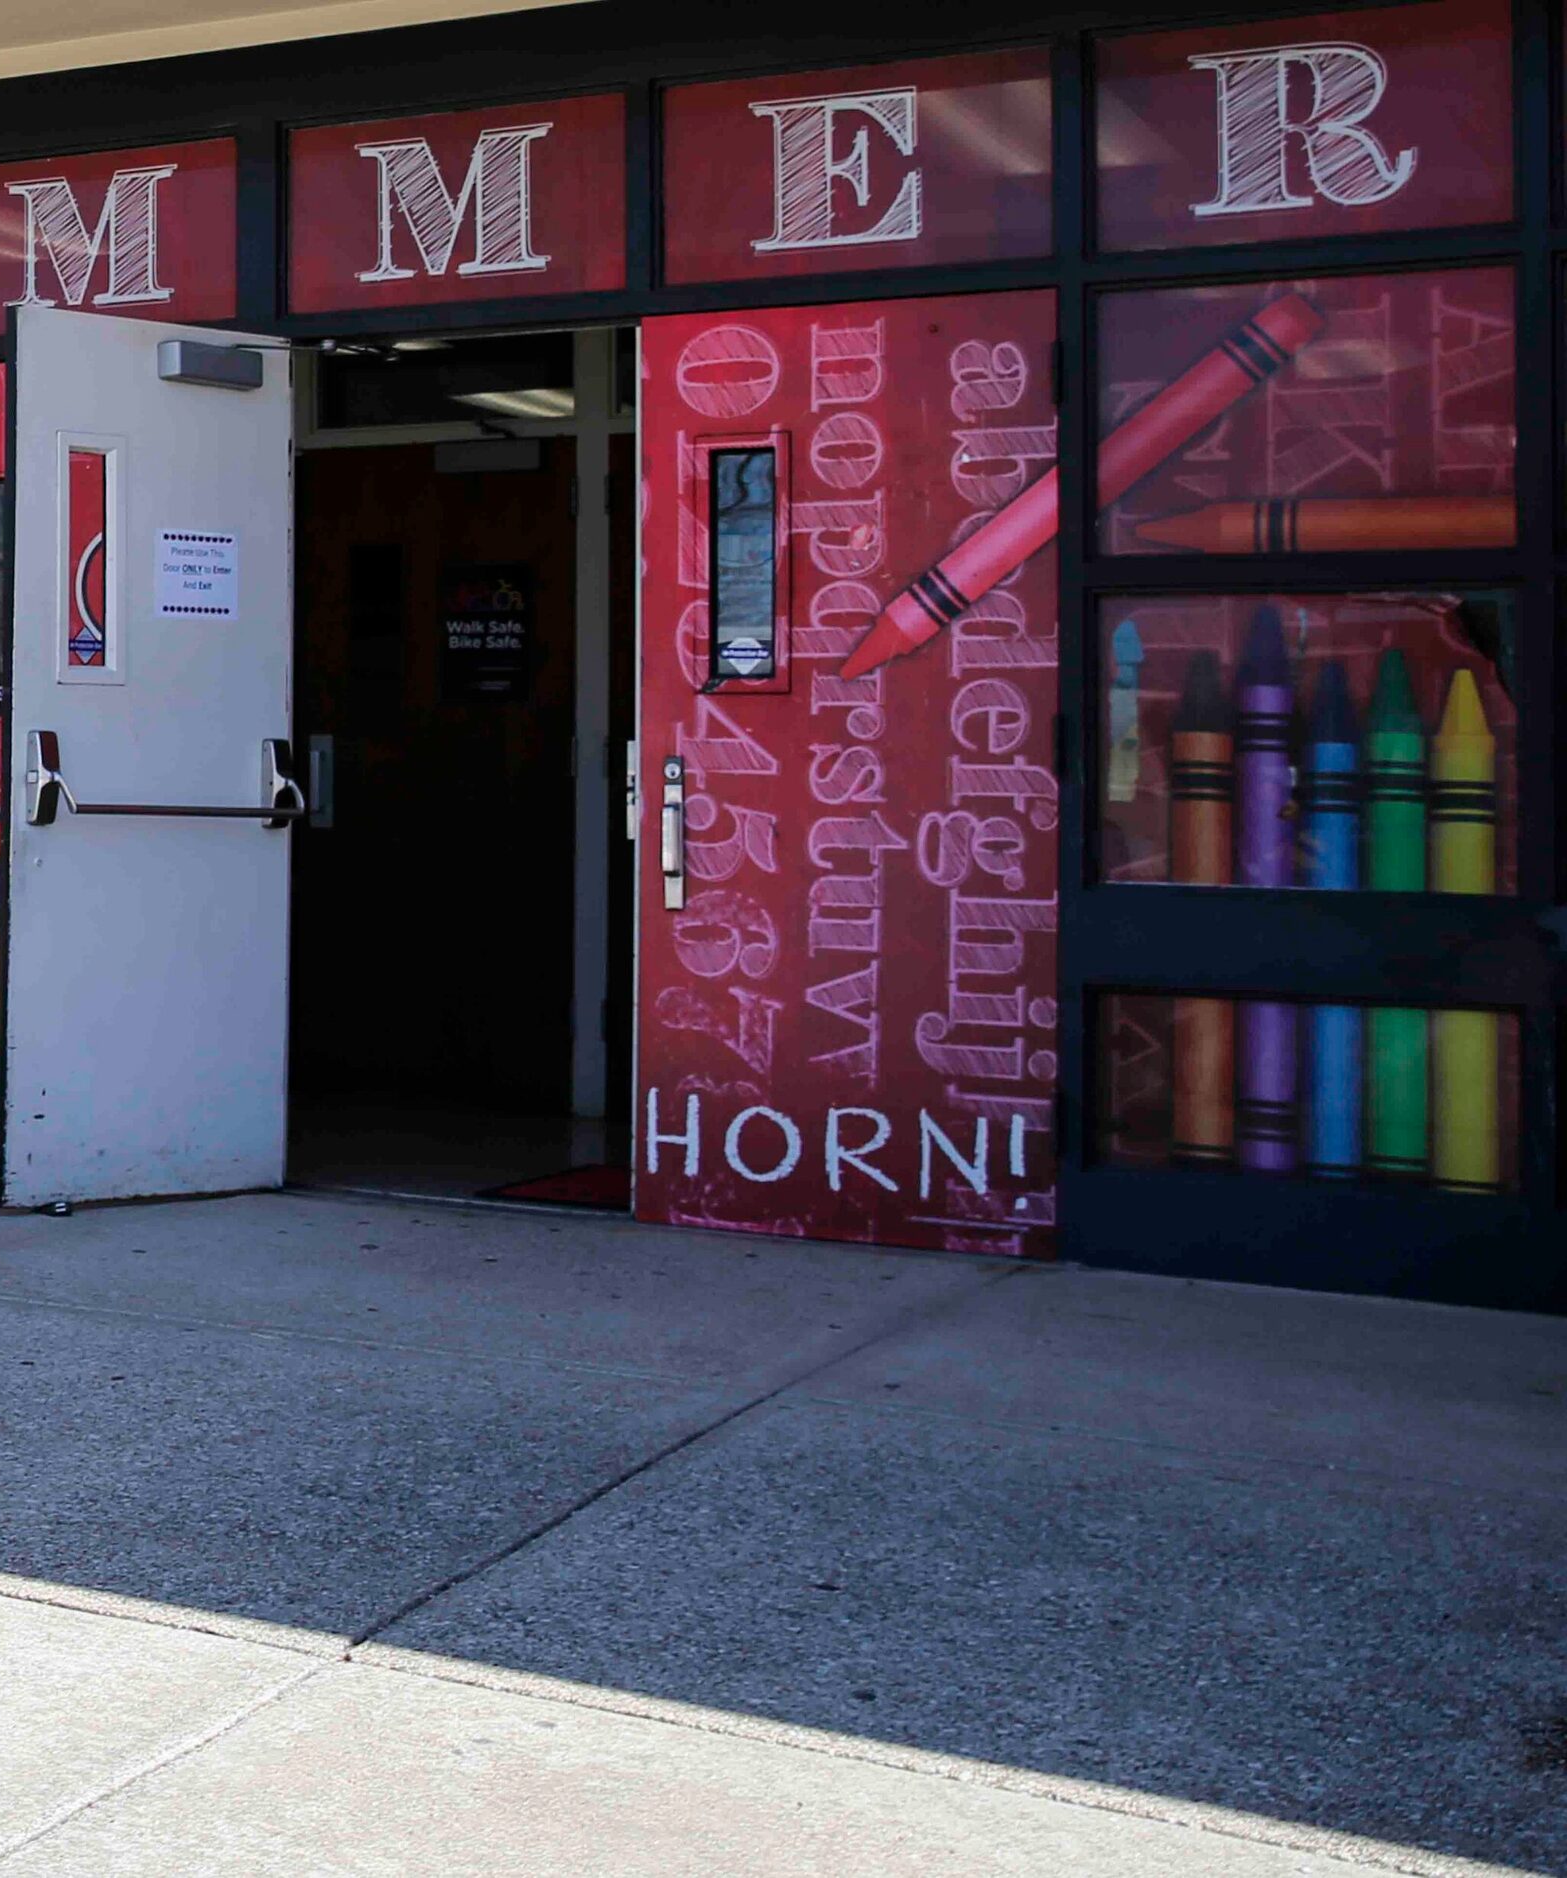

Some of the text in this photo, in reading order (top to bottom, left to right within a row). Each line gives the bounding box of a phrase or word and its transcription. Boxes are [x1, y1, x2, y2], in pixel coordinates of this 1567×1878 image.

[182, 564, 202, 574] ONLY
[446, 620, 525, 633] Walk Safe.
[449, 635, 522, 649] Bike Safe.
[646, 1086, 1028, 1210] HORN!
